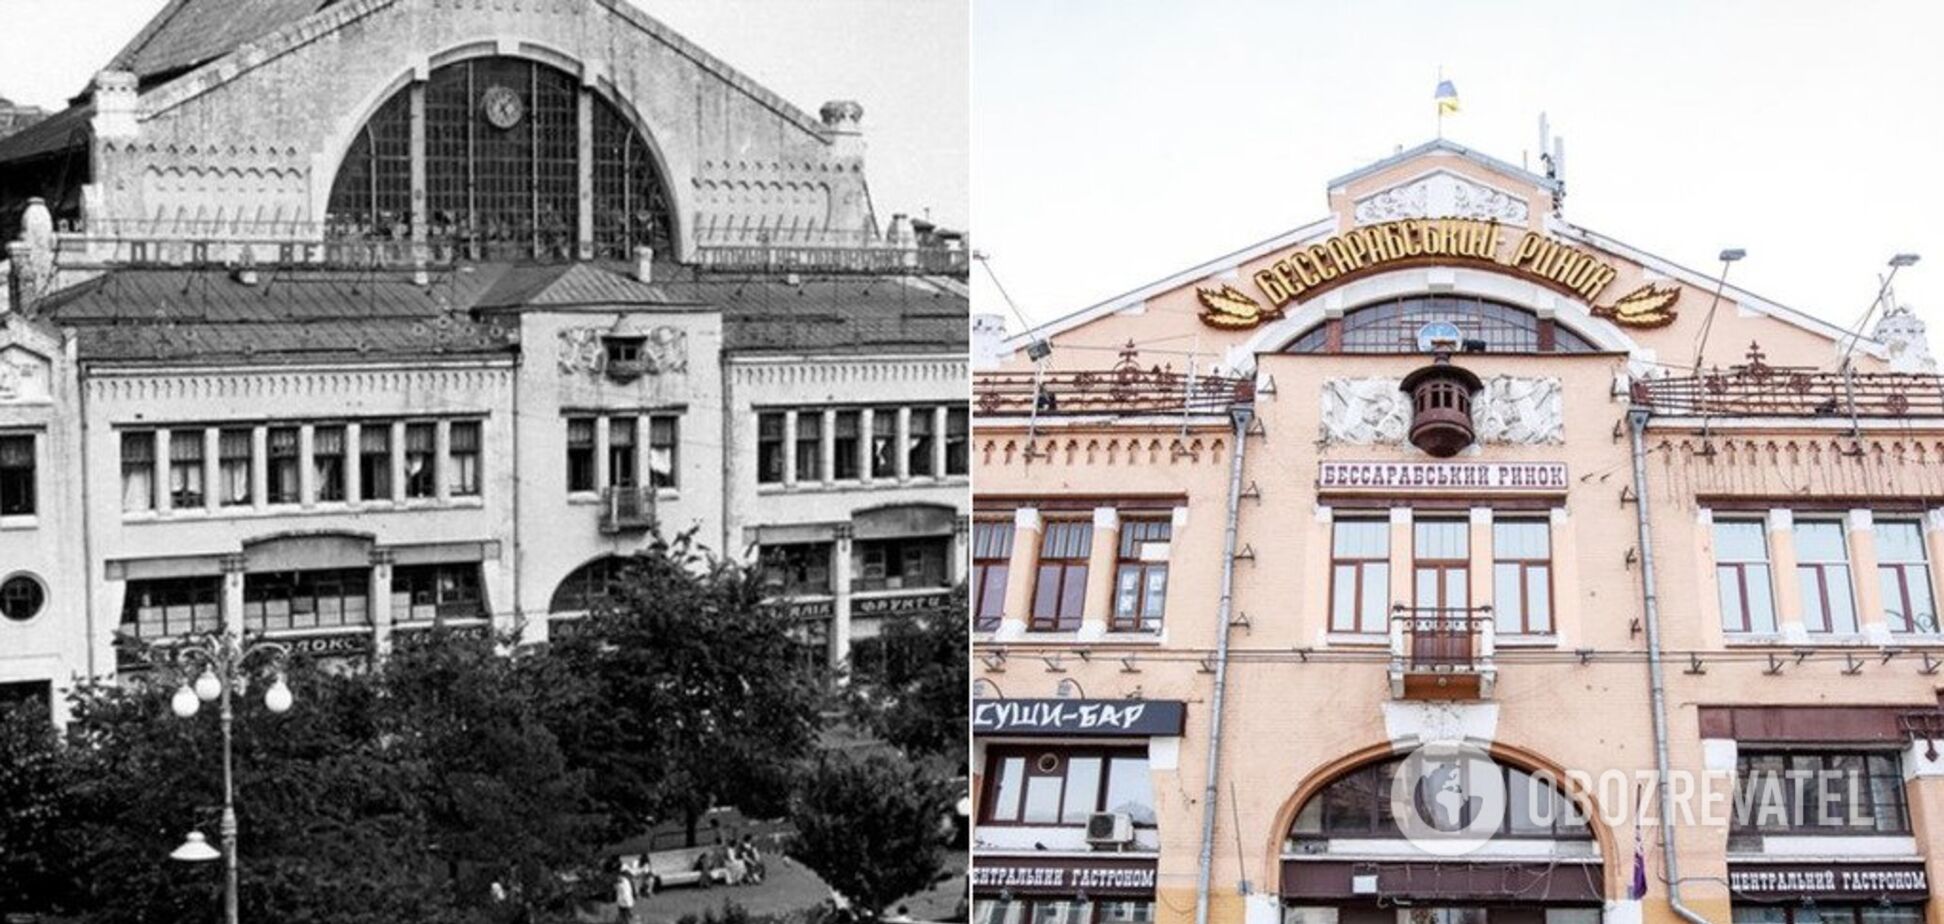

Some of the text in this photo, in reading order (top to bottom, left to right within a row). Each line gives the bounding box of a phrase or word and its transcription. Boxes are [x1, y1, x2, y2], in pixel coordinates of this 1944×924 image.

[1254, 217, 1617, 306] БЕССАРАБСЬКИЙ РИНОК
[1324, 465, 1563, 485] БЕССАРАБСЬКИЙ РИНОК
[974, 701, 1147, 730] СУШИ-БАР
[1071, 868, 1155, 888] ГАСТРОНОМ
[1731, 869, 1927, 892] ЦЕНТРАЛЬНИЙ ГАСТРОНОМ
